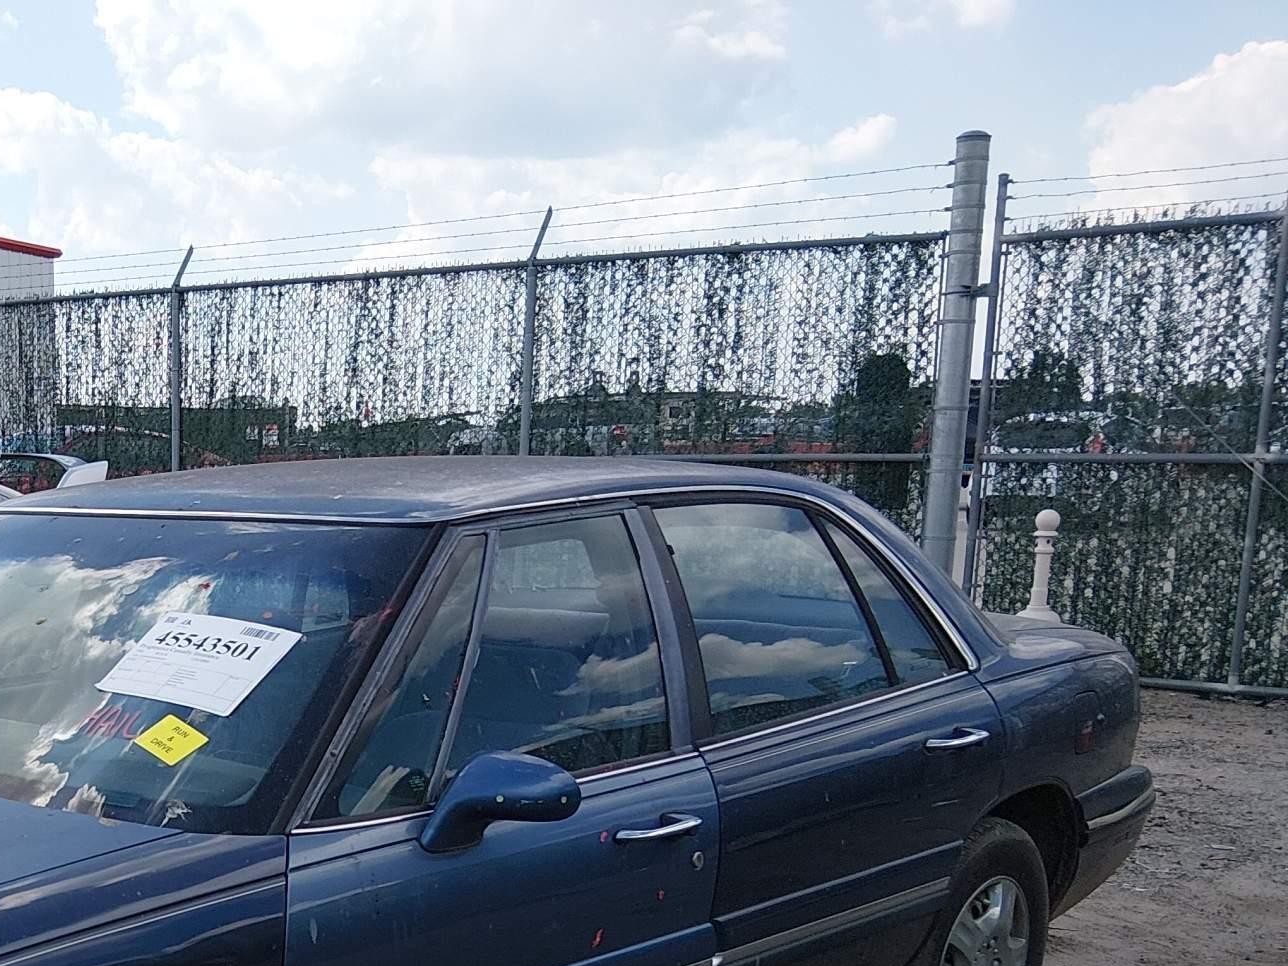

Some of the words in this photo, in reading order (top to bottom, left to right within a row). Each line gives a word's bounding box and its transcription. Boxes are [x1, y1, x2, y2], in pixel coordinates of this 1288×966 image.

[155, 631, 262, 660] 45543501
[172, 726, 190, 738] RUN
[150, 737, 173, 754] DRIVE
